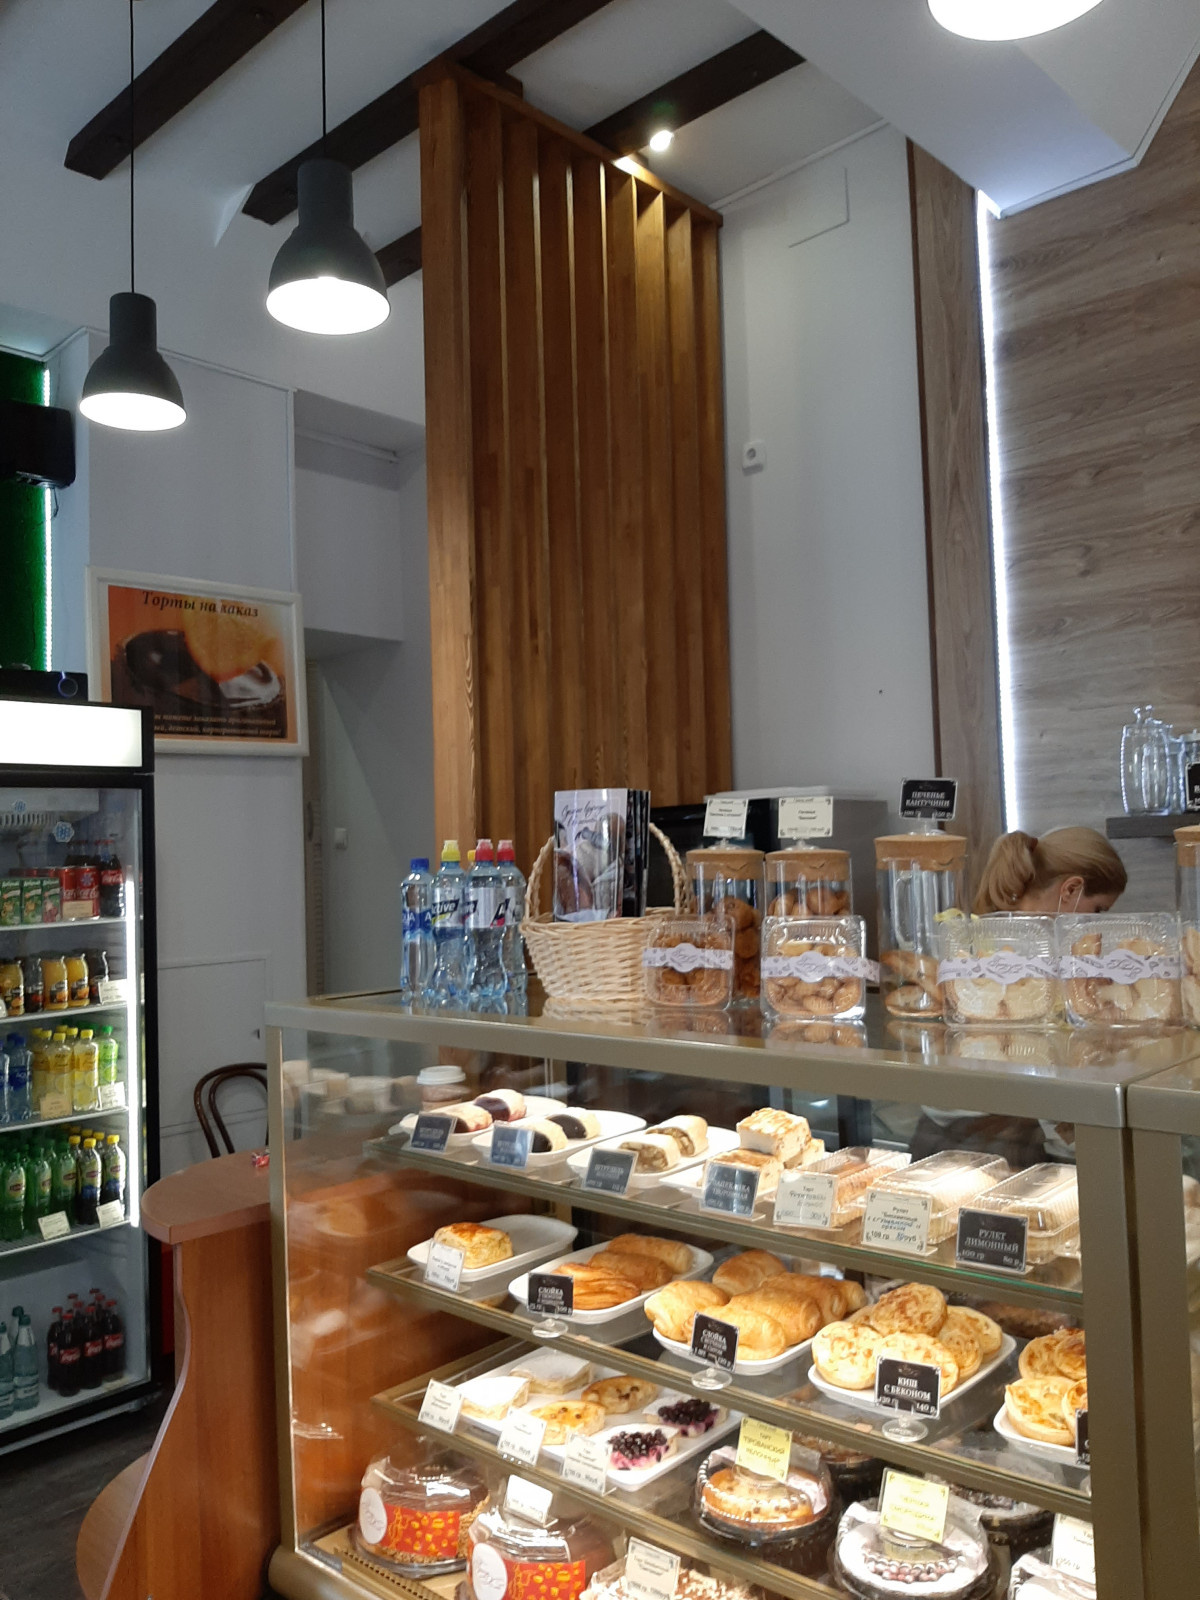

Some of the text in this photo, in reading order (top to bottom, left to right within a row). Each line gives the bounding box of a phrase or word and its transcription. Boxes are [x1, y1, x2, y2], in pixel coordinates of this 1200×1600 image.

[142, 590, 259, 617] Торты на заказ
[911, 791, 946, 799] ПЕЧЕНЬЕ
[712, 1179, 750, 1192] АПЕКНКА
[979, 1228, 1007, 1240] РУЛЕТ
[964, 1237, 1019, 1253] ЛИМОННЫЙ
[898, 1377, 918, 1388] КИШ
[883, 1384, 931, 1401] С БЕКОНОМ
[916, 1402, 930, 1412] 140
